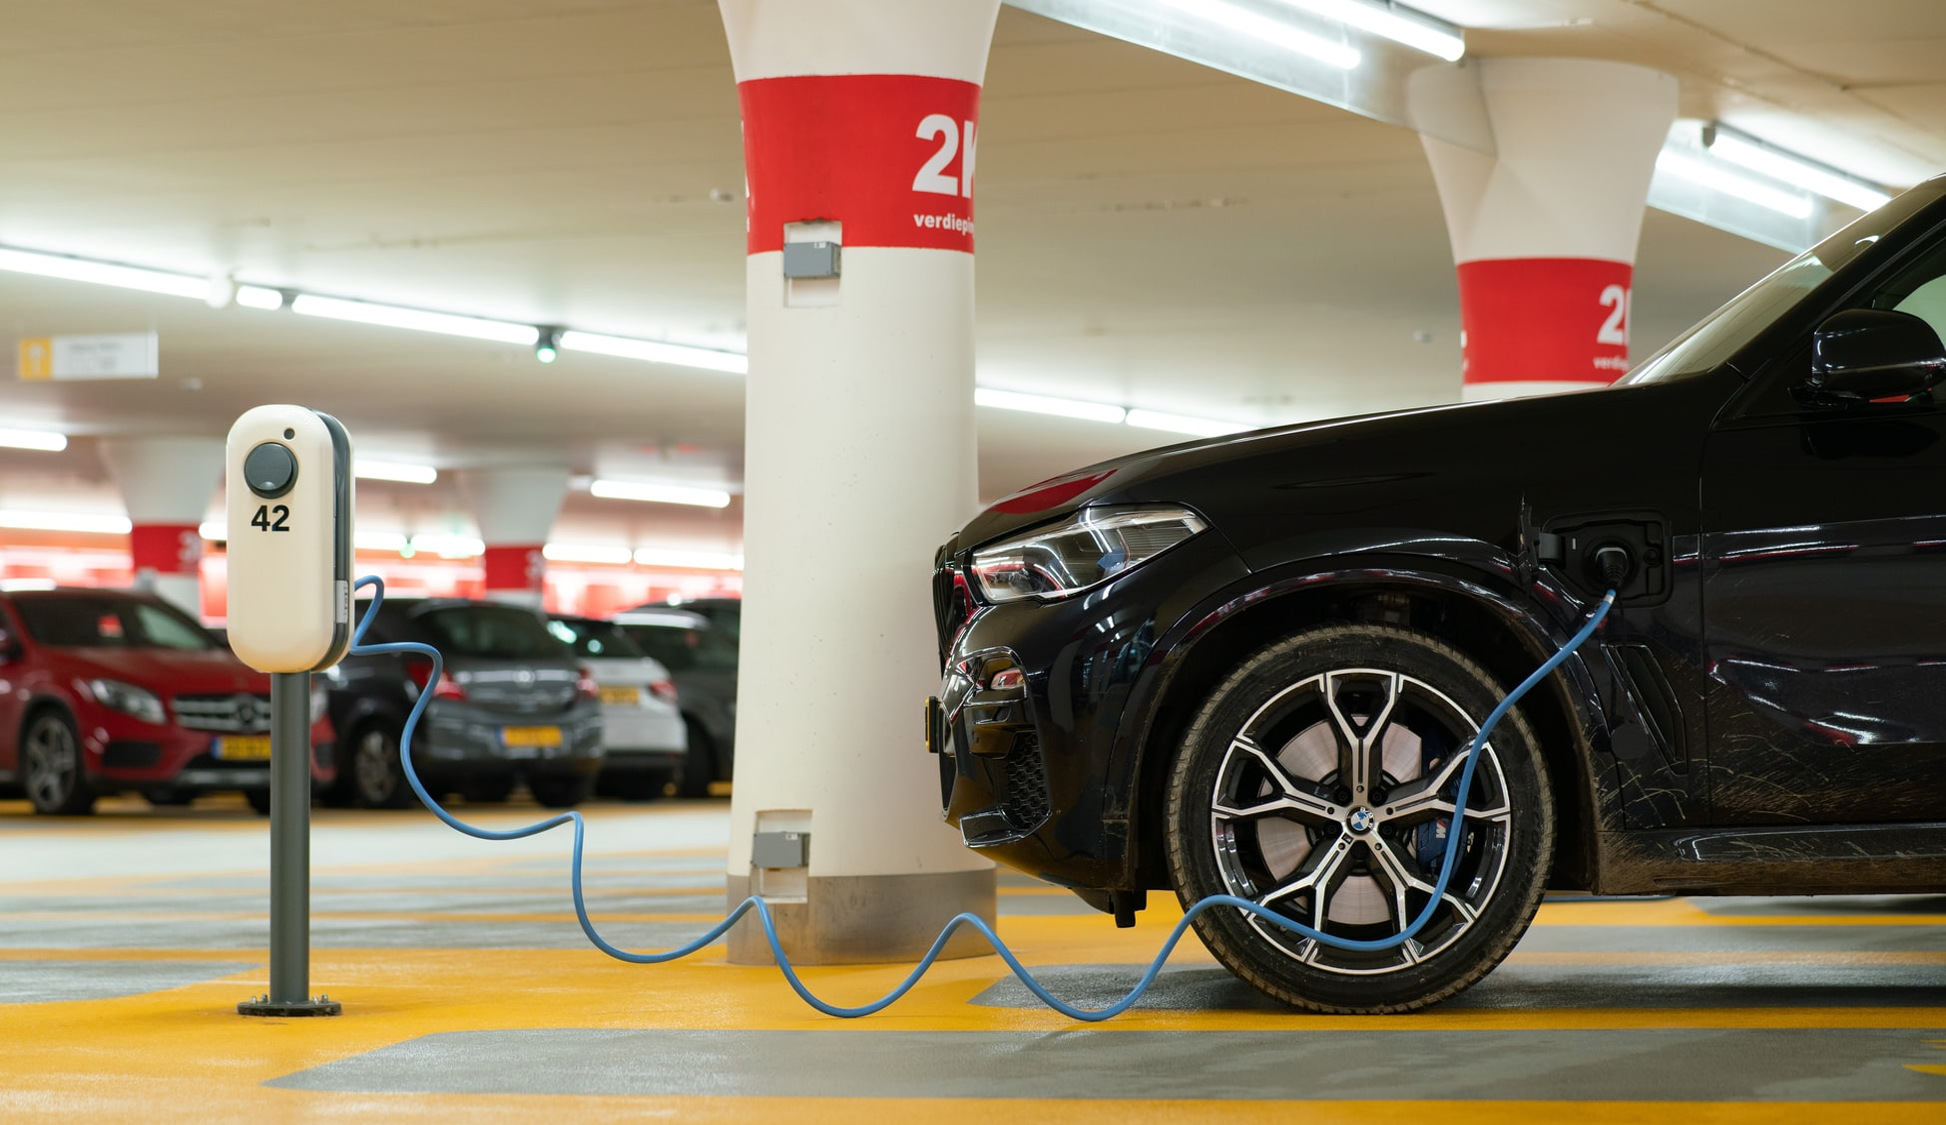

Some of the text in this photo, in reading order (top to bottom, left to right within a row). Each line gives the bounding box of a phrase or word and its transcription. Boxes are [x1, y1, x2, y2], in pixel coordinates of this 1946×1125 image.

[913, 213, 974, 237] verdiepin
[1597, 284, 1631, 346] 2
[251, 504, 290, 532] 42
